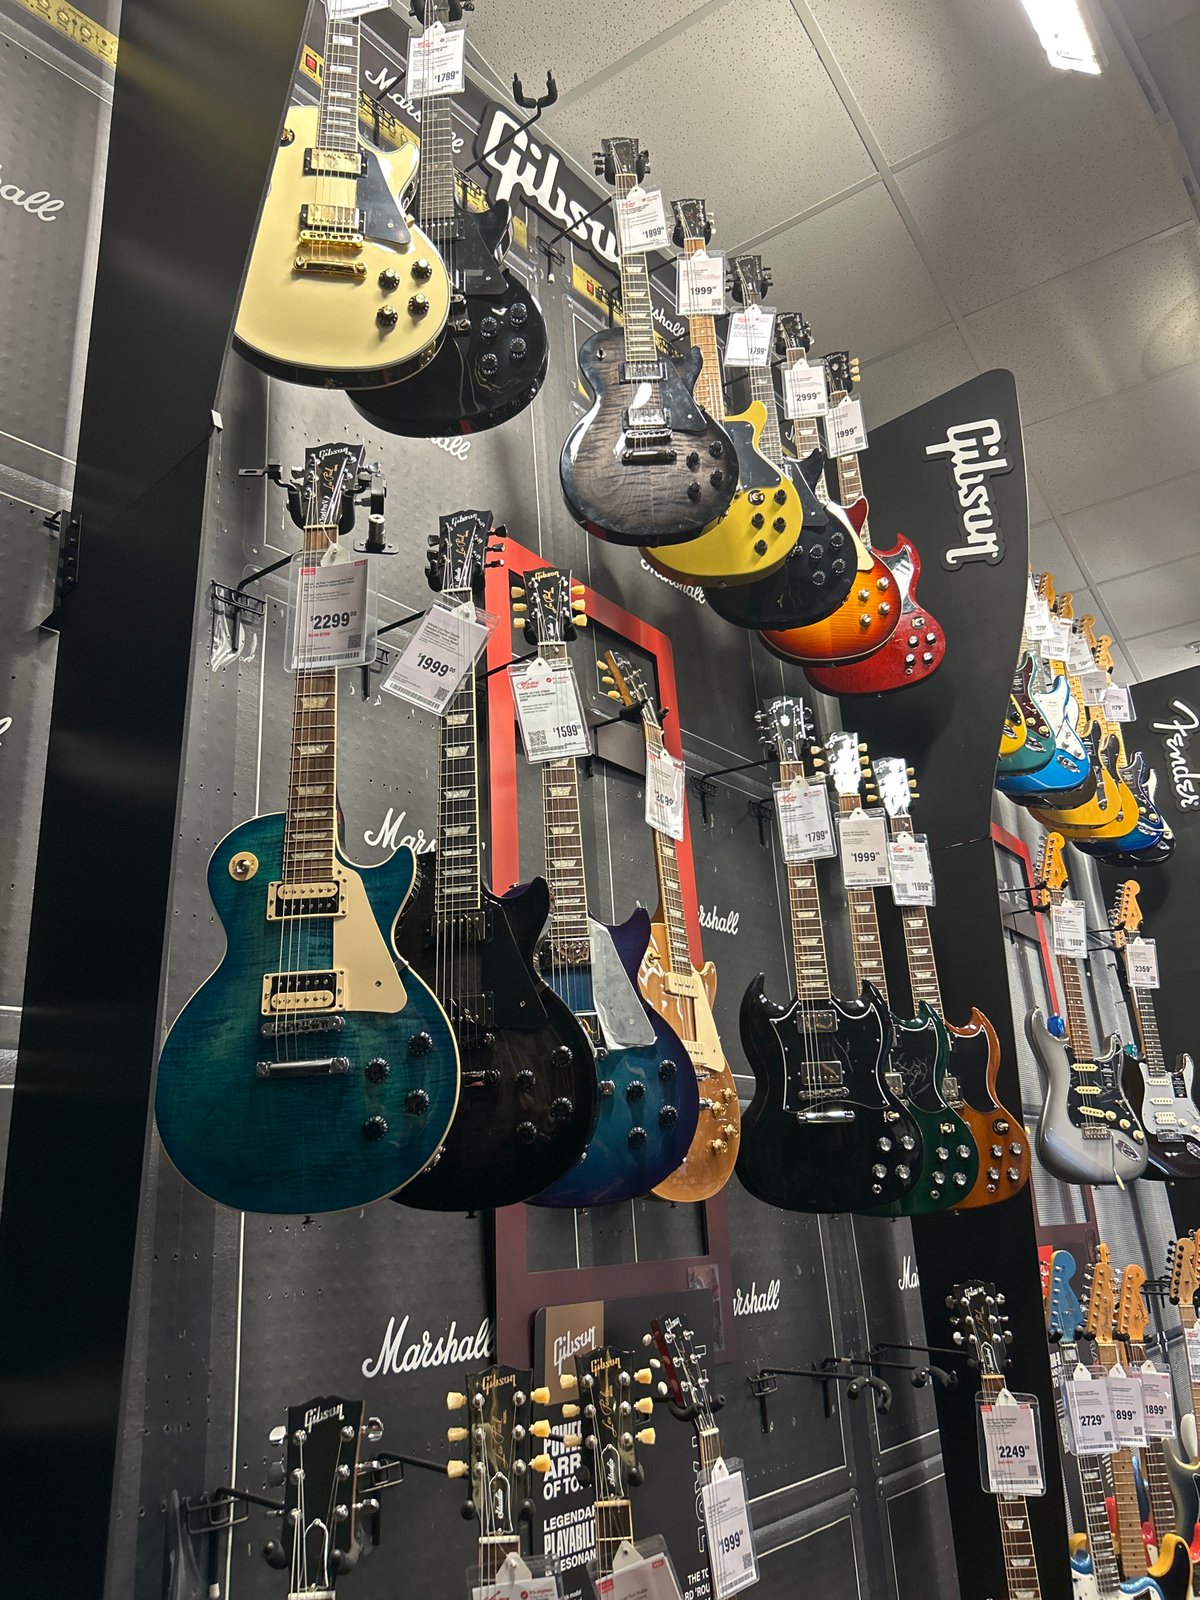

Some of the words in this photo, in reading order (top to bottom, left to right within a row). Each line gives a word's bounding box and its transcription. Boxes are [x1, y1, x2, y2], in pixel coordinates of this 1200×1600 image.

[650, 303, 685, 341] shall
[319, 447, 349, 460] Gibson
[925, 418, 1008, 564] Gibson
[451, 513, 478, 527] Gibson
[534, 570, 560, 582] Gibson
[1153, 700, 1200, 808] Fender
[698, 904, 740, 935] rshall
[361, 1314, 495, 1379] Marshall
[553, 1325, 597, 1376] Gibson
[590, 1356, 622, 1377] Gibson
[481, 1373, 517, 1396] Gibson
[304, 1403, 345, 1433] Gibson
[543, 1480, 561, 1500] OF
[543, 1519, 597, 1560] PLAYABILI
[687, 1571, 701, 1586] THE
